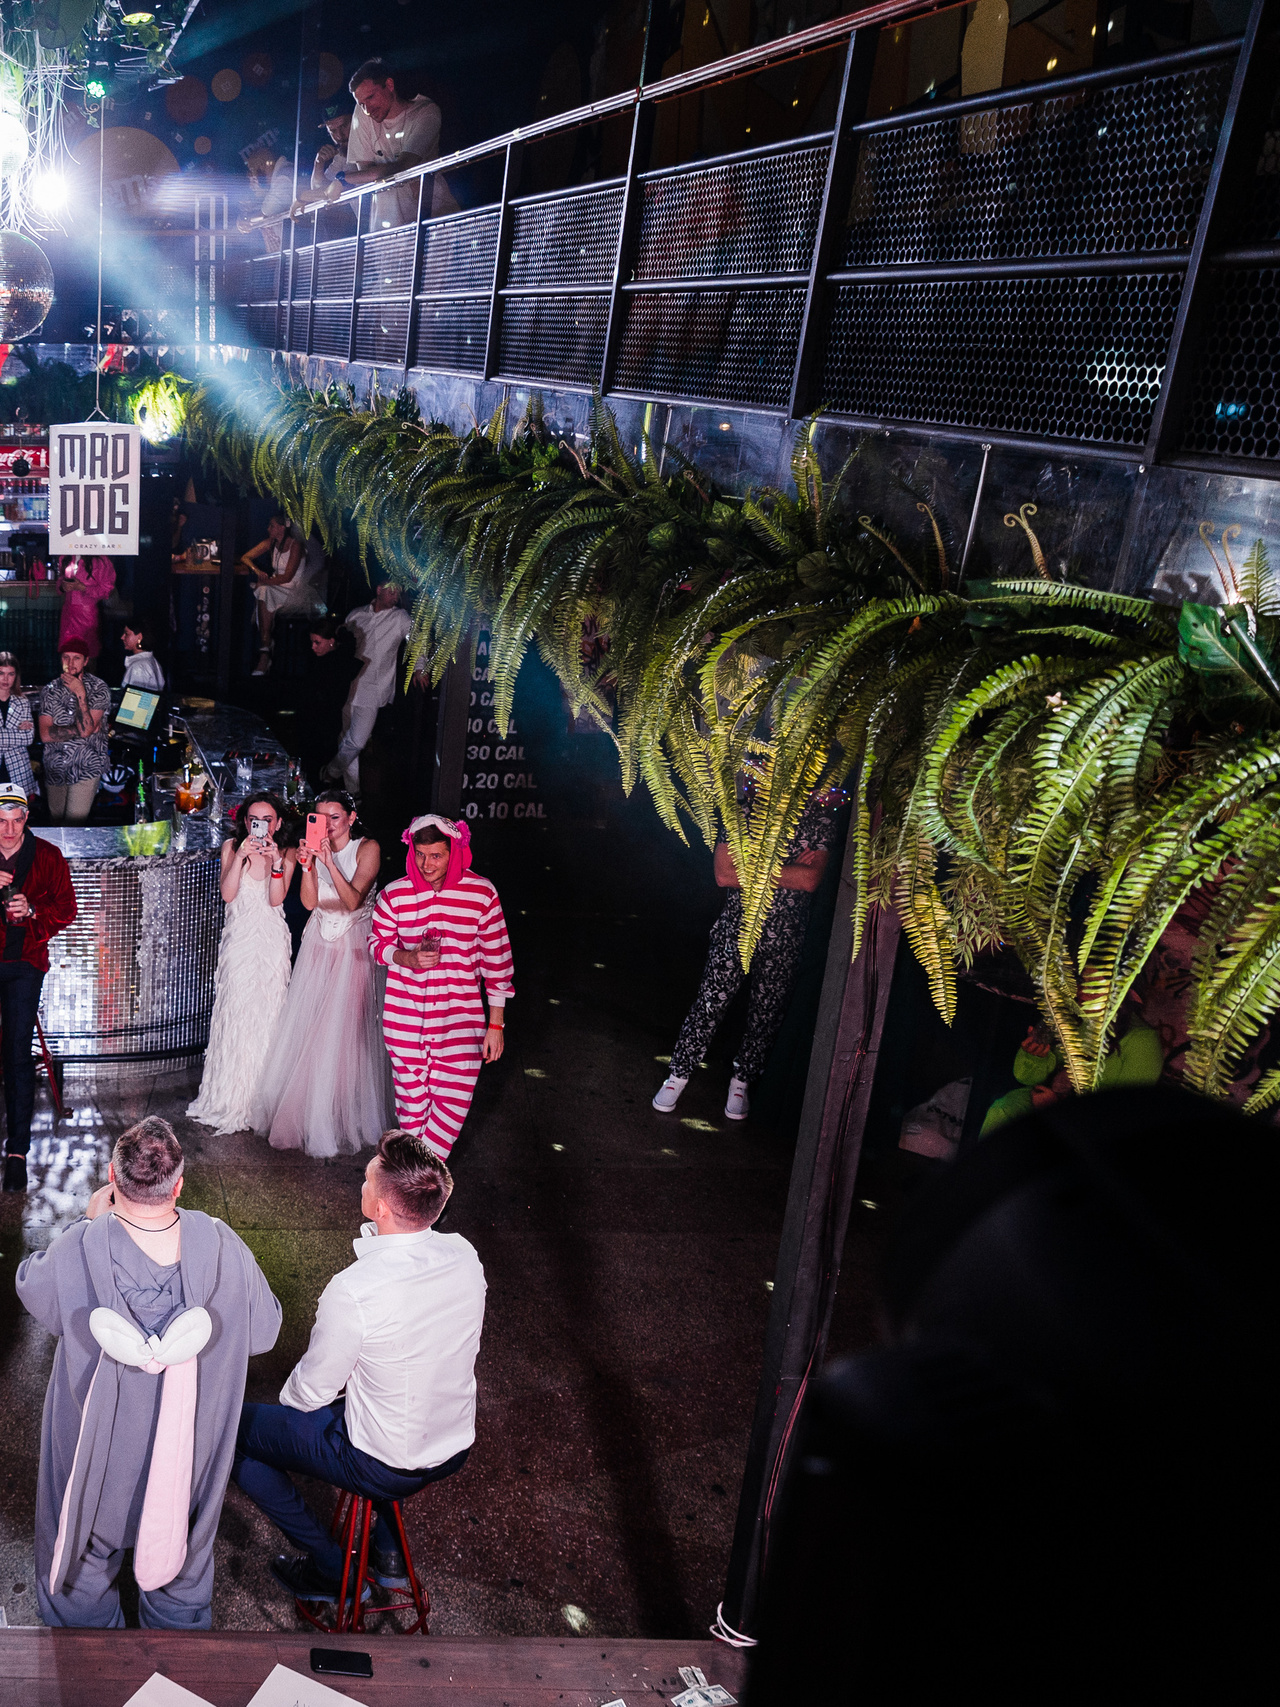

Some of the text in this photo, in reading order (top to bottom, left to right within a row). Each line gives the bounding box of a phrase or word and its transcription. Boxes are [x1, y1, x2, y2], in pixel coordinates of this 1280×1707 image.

[58, 432, 130, 481] MAD
[59, 483, 129, 537] DOG
[494, 745, 526, 761] CAL
[503, 773, 537, 789] CAL
[513, 802, 547, 818] CAL
